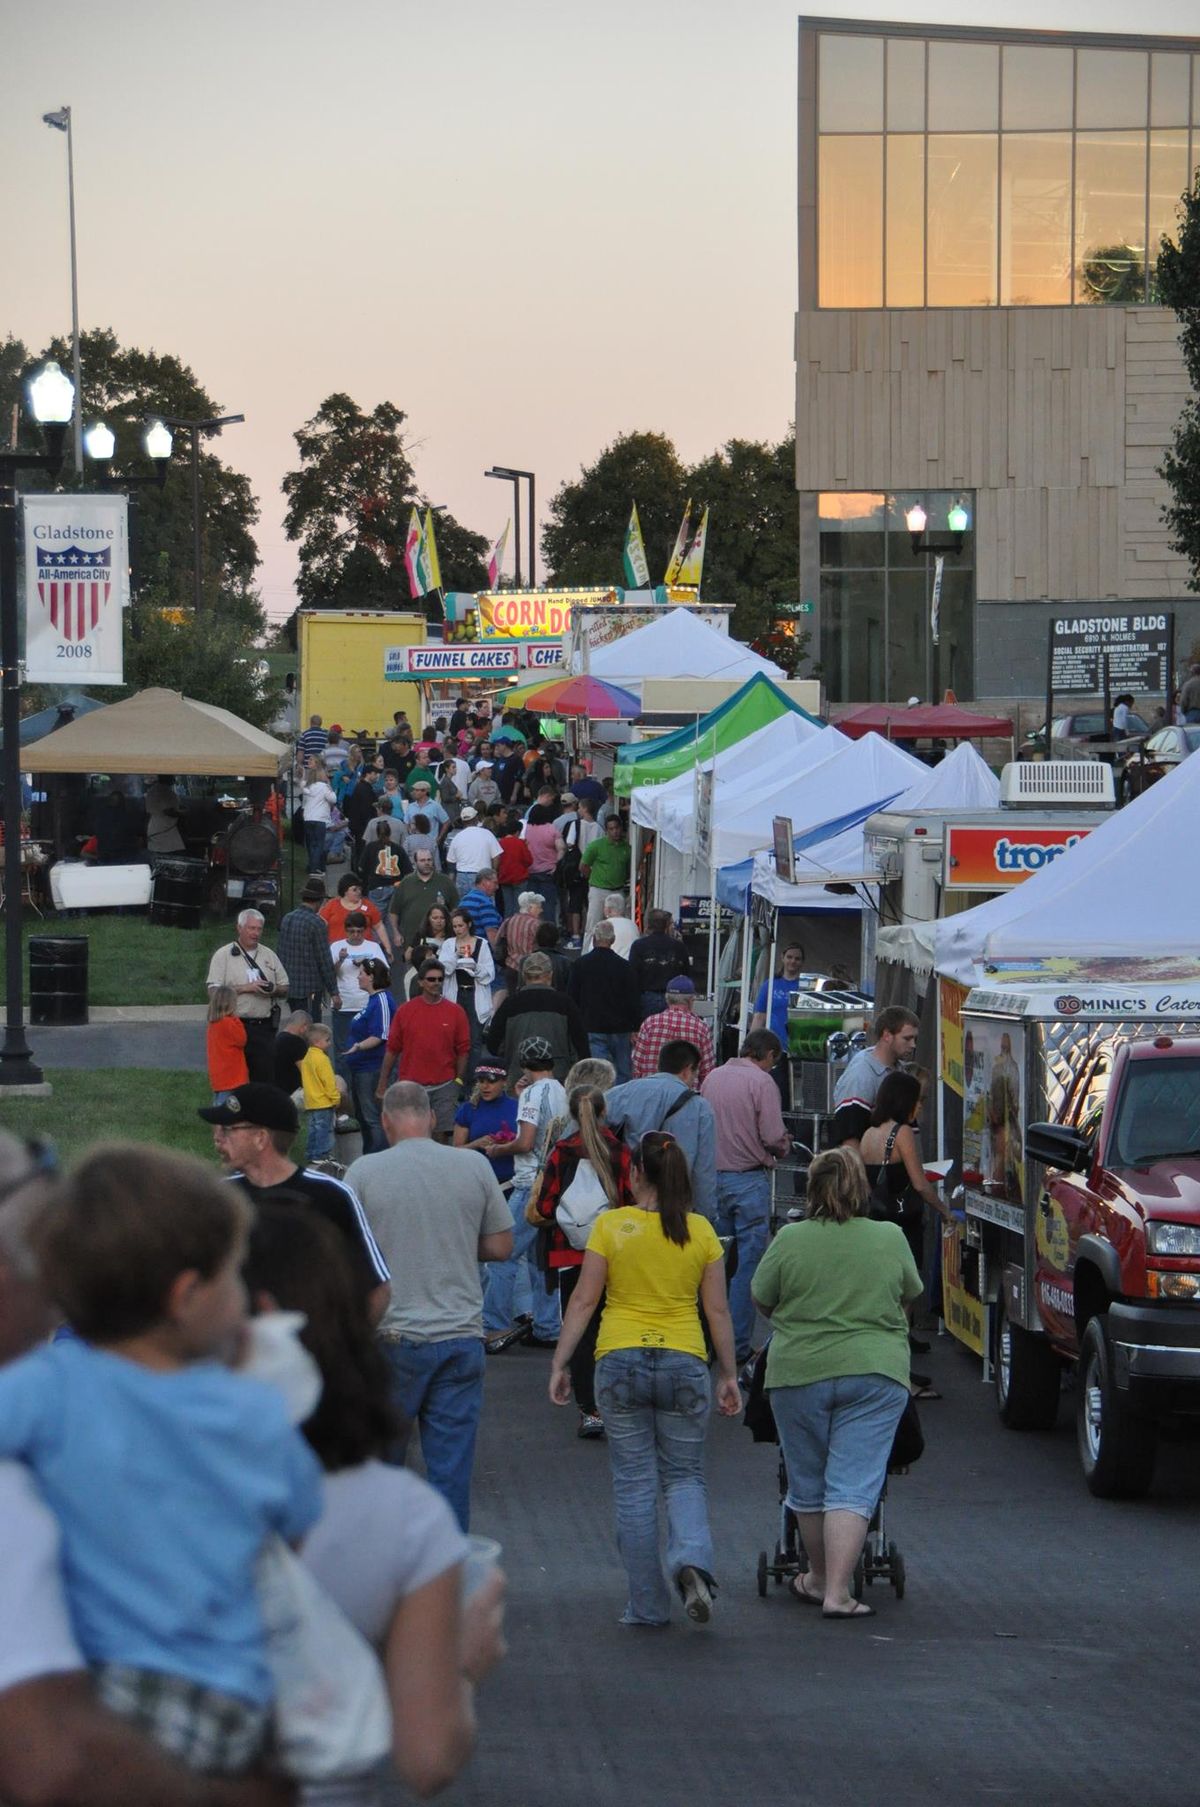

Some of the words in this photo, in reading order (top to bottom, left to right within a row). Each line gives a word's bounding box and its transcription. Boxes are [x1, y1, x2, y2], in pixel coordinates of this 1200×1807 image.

[33, 525, 114, 540] Gladstone
[38, 568, 92, 580] All-America
[93, 568, 111, 581] City
[493, 600, 546, 626] CORN
[1055, 617, 1128, 634] GLADSTONE
[1133, 615, 1166, 631] BLDG
[1110, 632, 1136, 642] HOLMES
[56, 645, 92, 658] 2008
[1054, 646, 1073, 655] SOCIAL
[1074, 645, 1101, 654] SECURITY
[1103, 643, 1149, 653] ADMINISTRATION
[416, 653, 466, 667] FUNNEL
[470, 651, 511, 666] CAKES
[1055, 997, 1146, 1011] DOMINIC'S
